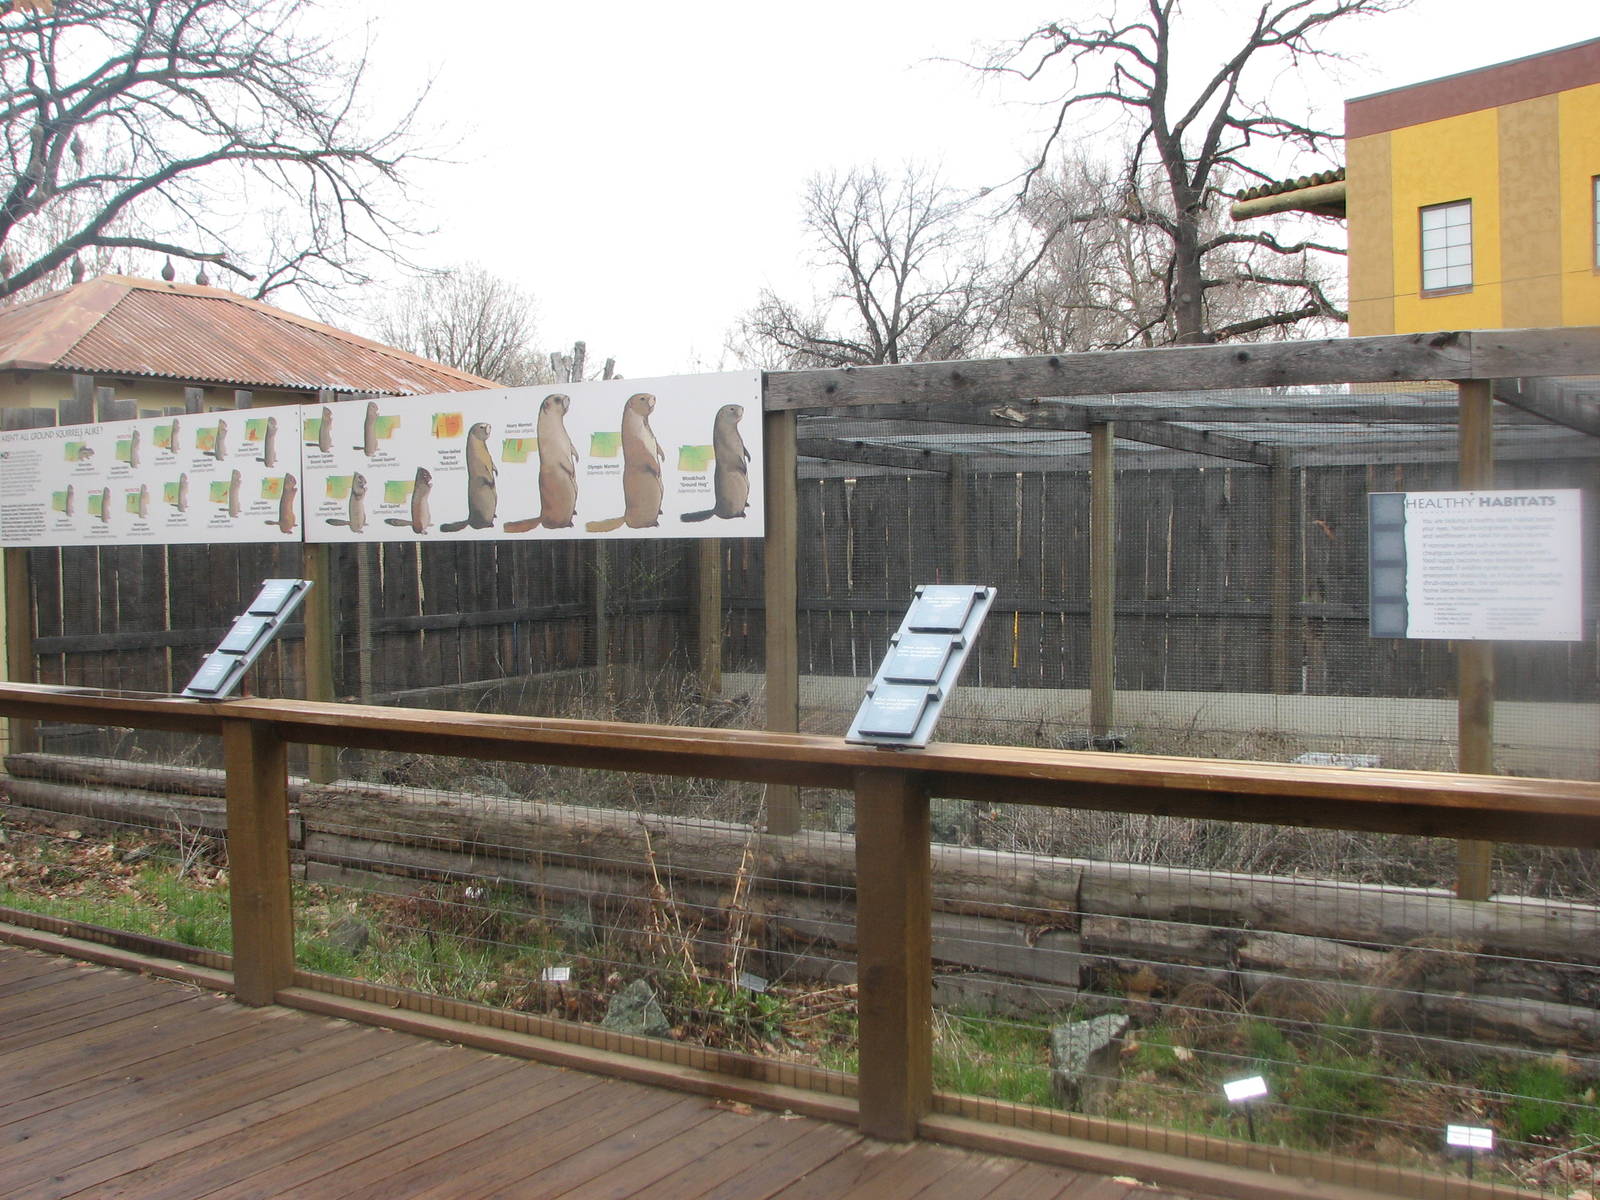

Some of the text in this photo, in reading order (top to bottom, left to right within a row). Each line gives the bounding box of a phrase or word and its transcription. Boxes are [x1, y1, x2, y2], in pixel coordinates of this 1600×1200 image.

[30, 430, 54, 440] GROUND
[1406, 496, 1556, 509] HEALTHY HABITATS
